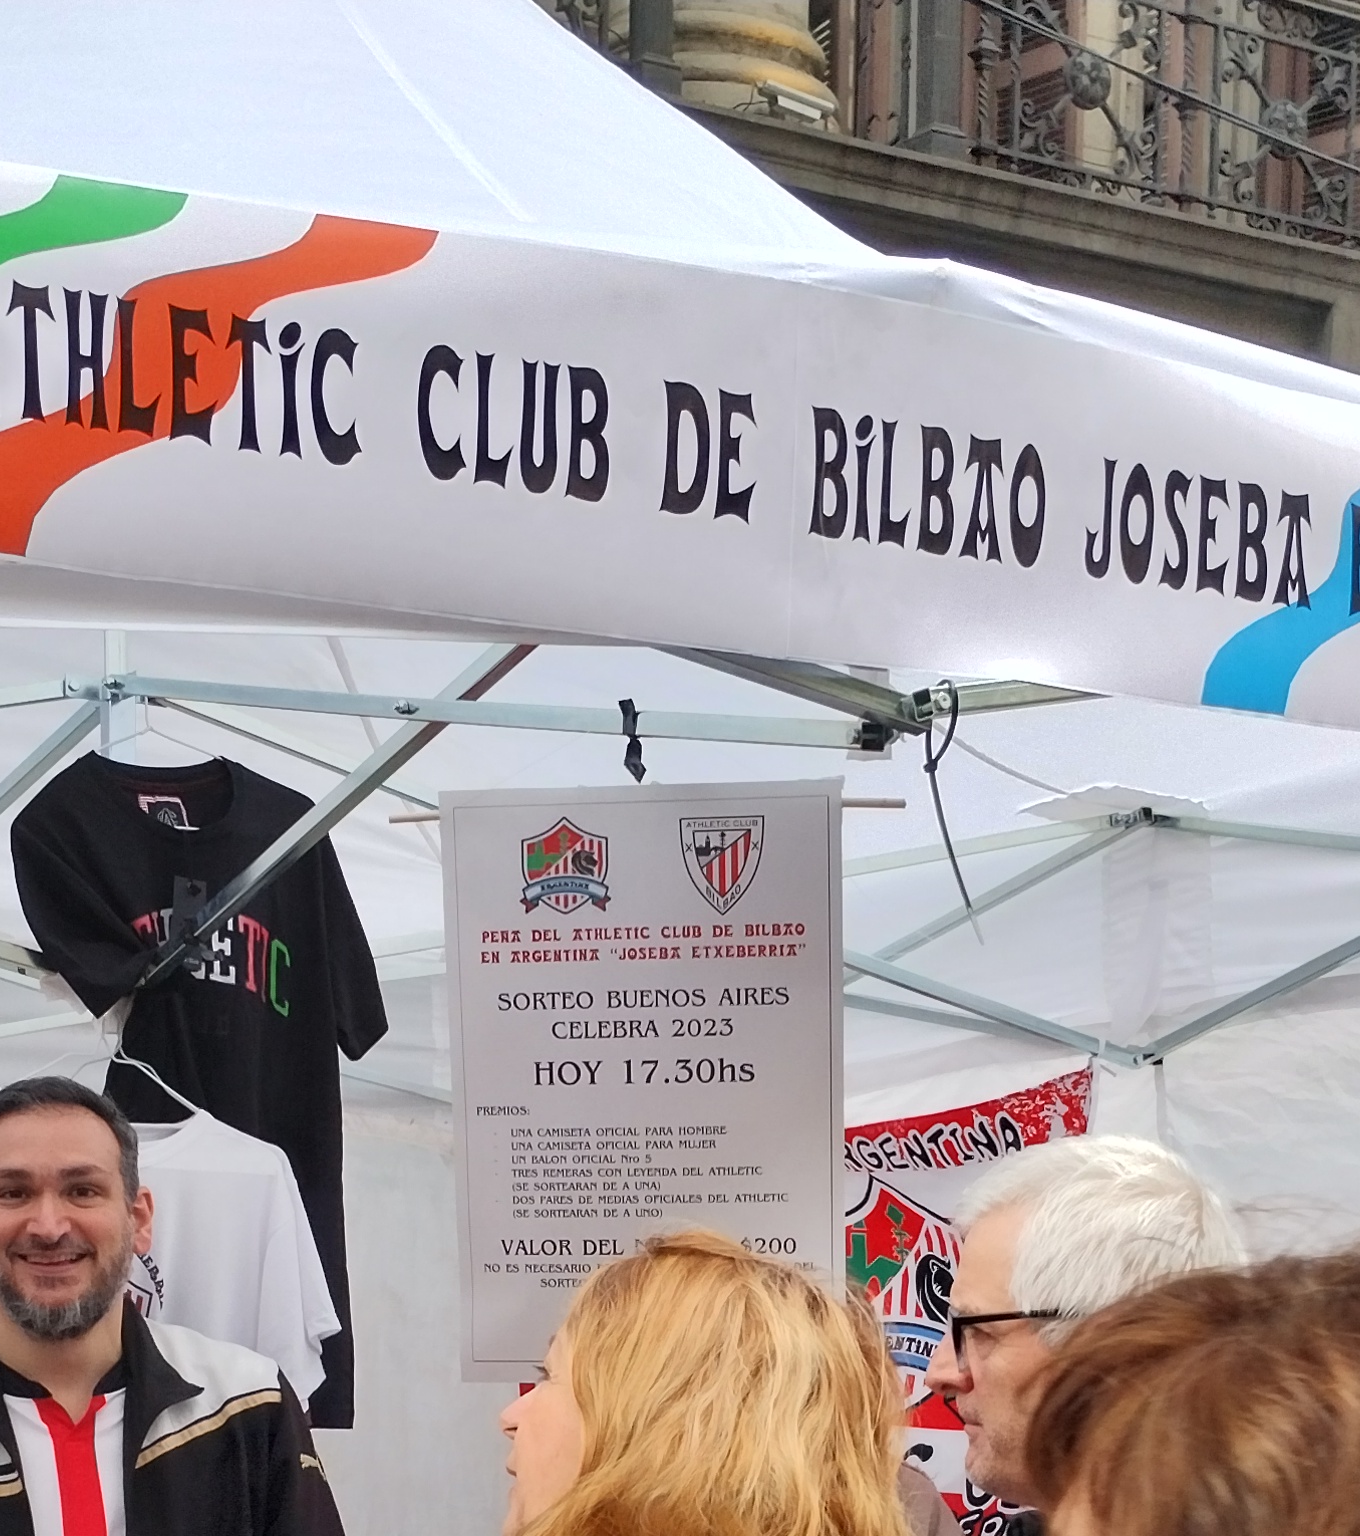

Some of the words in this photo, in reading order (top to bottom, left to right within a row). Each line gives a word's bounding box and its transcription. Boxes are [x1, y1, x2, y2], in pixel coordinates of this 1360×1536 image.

[417, 345, 610, 502] CLUB
[659, 379, 757, 525] DE
[809, 404, 1046, 568] BILBAO
[1085, 457, 1312, 609] JOSEBA
[685, 820, 730, 828] ATHLETIC
[733, 819, 759, 827] CLUB
[705, 883, 742, 911] BILBAO
[532, 929, 561, 942] DEL
[572, 927, 651, 941] ATHLETIC
[661, 925, 702, 939] CLUB
[712, 925, 734, 938] DE
[744, 923, 806, 937] BILBAO
[481, 951, 500, 964] EN
[510, 948, 600, 963] ARGENTINA
[498, 990, 594, 1011] SORTEO
[606, 988, 706, 1009] BUENOS
[718, 986, 790, 1007] AIRES
[551, 1019, 660, 1039] CELEBRA
[671, 1018, 734, 1038] 2023
[534, 1059, 604, 1086] HOY
[624, 1057, 756, 1086] 17.30hs
[476, 1105, 530, 1117] PREMIOS:
[511, 1128, 532, 1137] UNA
[537, 1128, 591, 1137] CAMISETA
[596, 1127, 639, 1136] OFICIAL
[645, 1127, 673, 1136] PARA
[678, 1125, 727, 1135] HOMBRE
[511, 1142, 532, 1151] UNA
[537, 1141, 591, 1150] CAMISETA
[596, 1141, 640, 1150] OFICIAL
[645, 1140, 673, 1149] PARA
[679, 1140, 716, 1149] MUJER
[512, 1155, 526, 1164] UN
[531, 1155, 567, 1164] BALON
[572, 1154, 616, 1164] OFICIAL
[621, 1154, 639, 1163] Nro
[511, 1169, 538, 1178] TRES
[543, 1168, 592, 1178] REMERAS
[597, 1168, 622, 1177] CON
[627, 1167, 677, 1177] LEYENDA
[682, 1167, 703, 1176] DEL
[708, 1166, 763, 1176] ATHLETIC
[533, 1182, 597, 1191] SORTEARAN
[603, 1182, 617, 1191] DE
[622, 1182, 630, 1191] A
[512, 1195, 535, 1205] DOS
[540, 1195, 573, 1204] PARES
[578, 1195, 592, 1204] DE
[598, 1195, 640, 1204] MEDIAS
[644, 1194, 702, 1204] OFICIALES
[708, 1194, 729, 1204] DEL
[734, 1193, 789, 1203] ATHLETIC
[534, 1209, 598, 1218] SORTEARAN
[603, 1209, 618, 1218] DE
[623, 1209, 630, 1218] A
[501, 1239, 572, 1255] VALOR
[582, 1239, 625, 1255] DEL
[484, 1263, 500, 1273] NO
[506, 1263, 519, 1273] ES
[524, 1263, 591, 1273] NECESARIO
